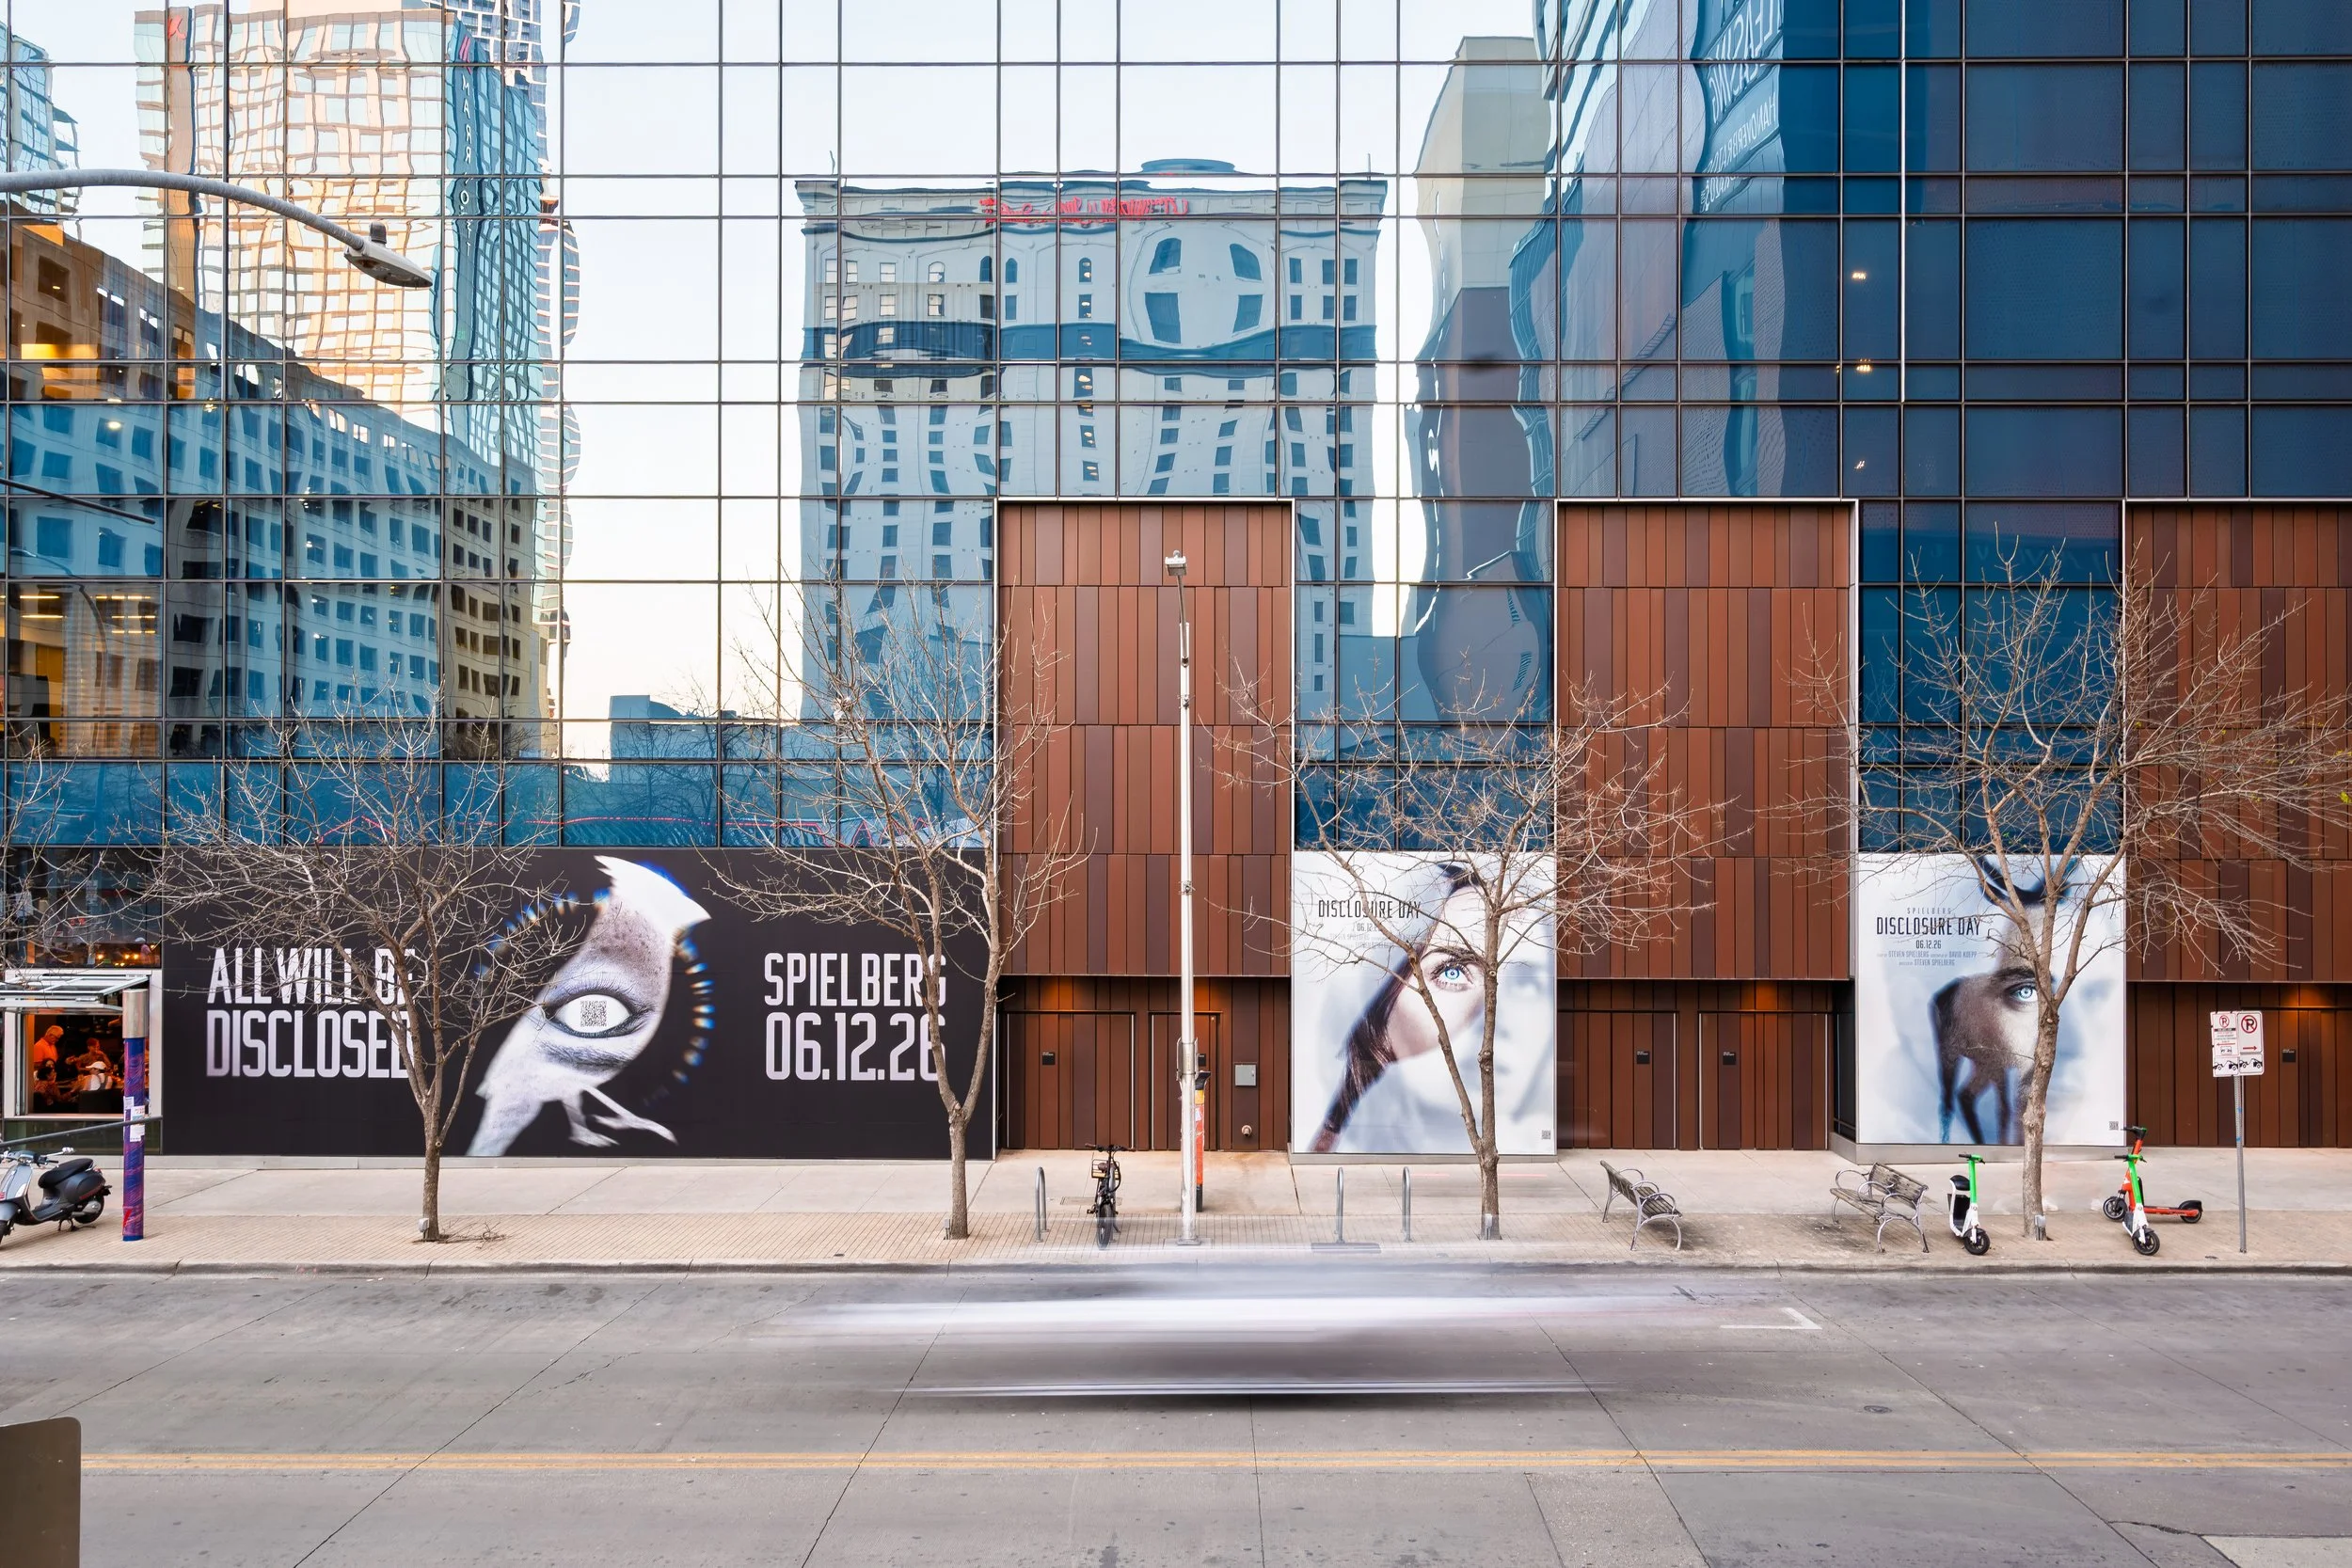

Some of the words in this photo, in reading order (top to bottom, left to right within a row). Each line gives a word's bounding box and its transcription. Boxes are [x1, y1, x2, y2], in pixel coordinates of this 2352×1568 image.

[1318, 899, 1392, 918] DISCLOURE
[1398, 900, 1422, 919] DAY
[1877, 916, 1952, 935] DISCLOSURE
[1958, 917, 1980, 935] DAY
[1915, 940, 1942, 949] 06.12.26
[207, 948, 272, 1004] ALL
[277, 948, 360, 1004] WILL
[764, 953, 946, 1006] SPIELBERG
[206, 1009, 415, 1078] DISCLOSED
[766, 1012, 946, 1081] 06.12.26
